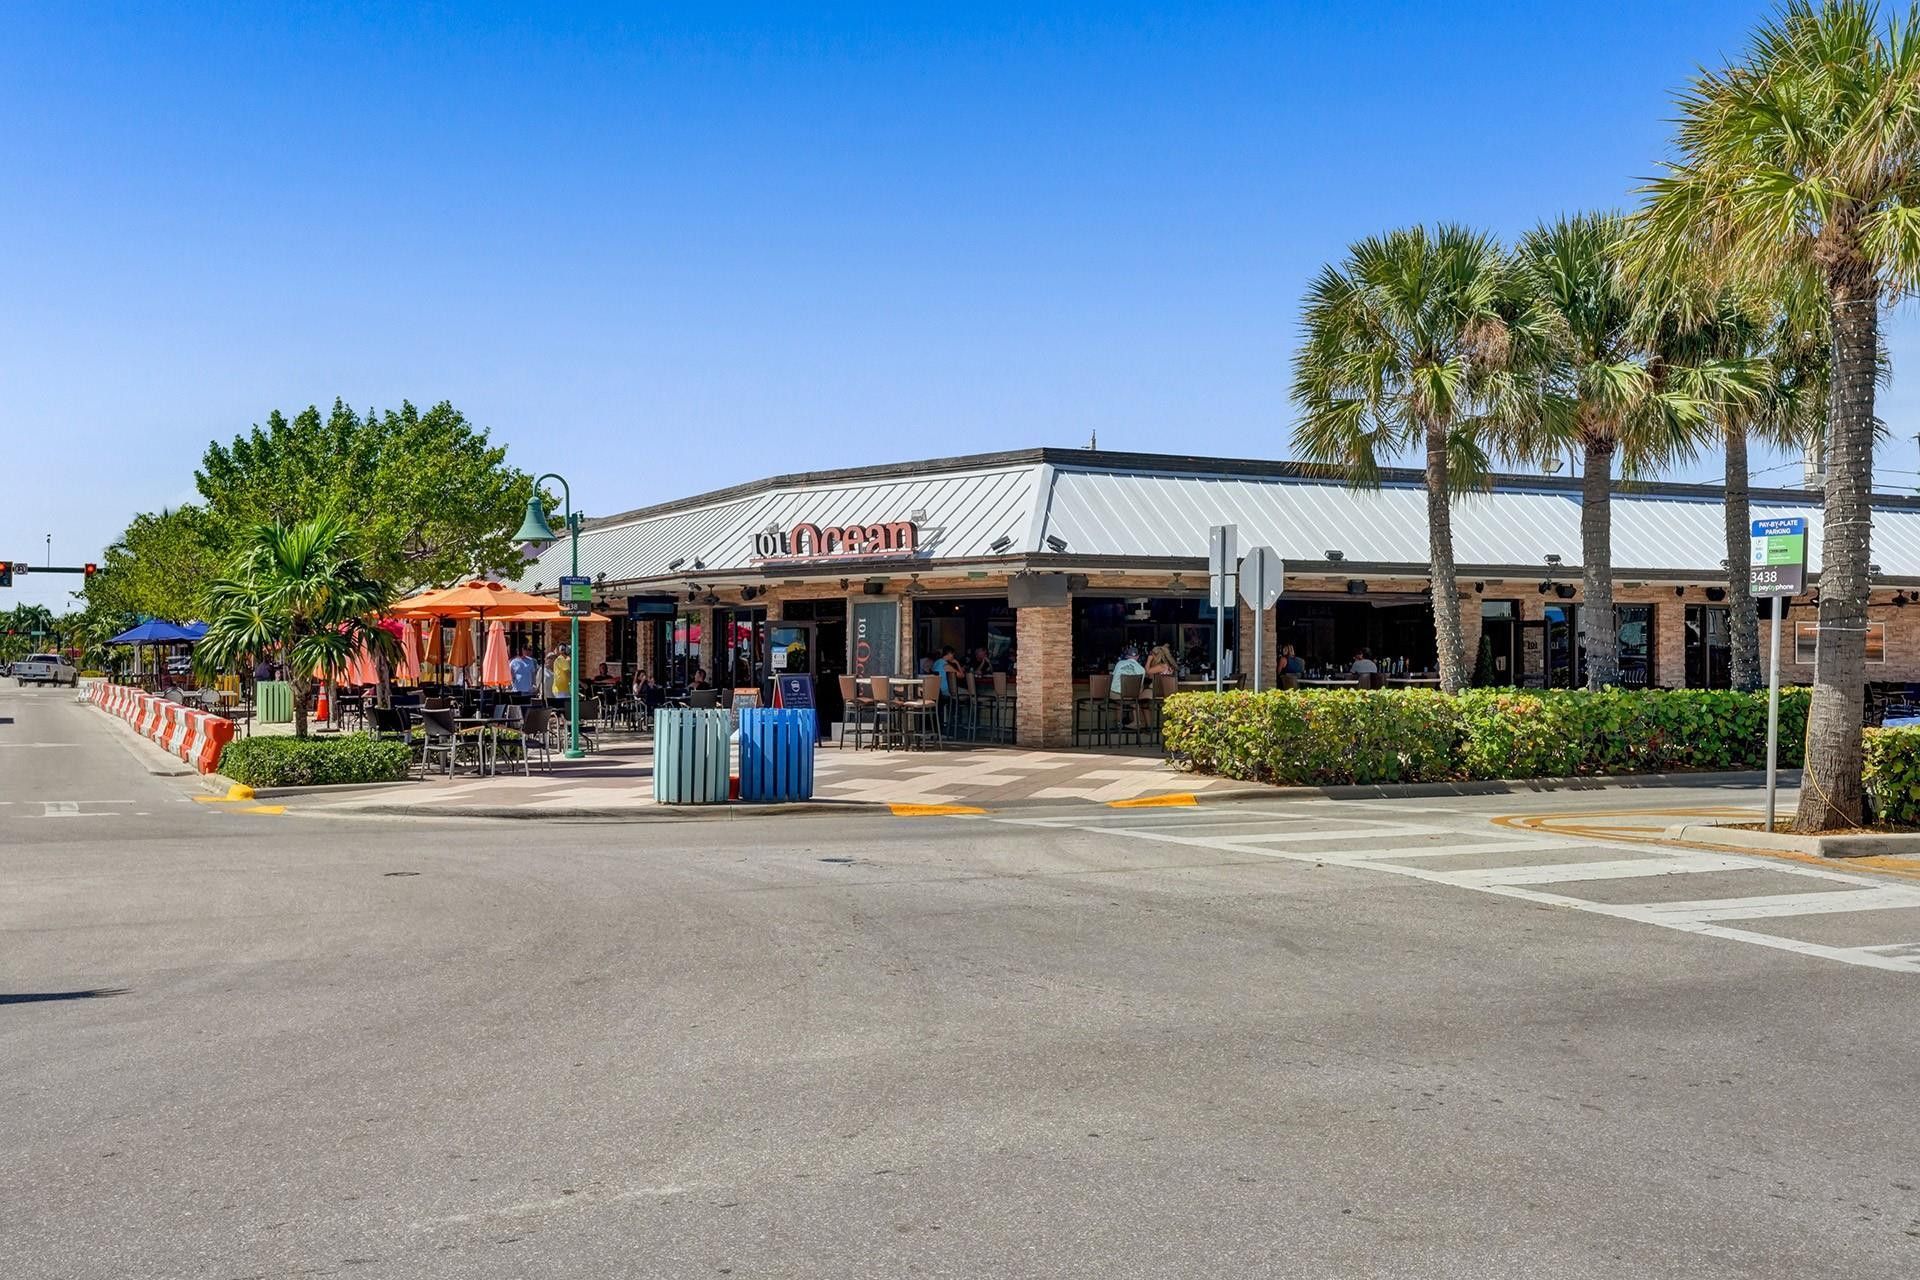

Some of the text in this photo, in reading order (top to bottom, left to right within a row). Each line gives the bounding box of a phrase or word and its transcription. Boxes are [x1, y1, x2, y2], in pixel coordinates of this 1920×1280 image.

[1758, 520, 1798, 528] PAY-BY-PLATE
[1765, 527, 1791, 535] PARKING
[749, 521, 917, 558] 101 Ocean
[1750, 571, 1777, 583] 3438
[1758, 583, 1794, 591] paybyphone
[858, 618, 867, 639] 101
